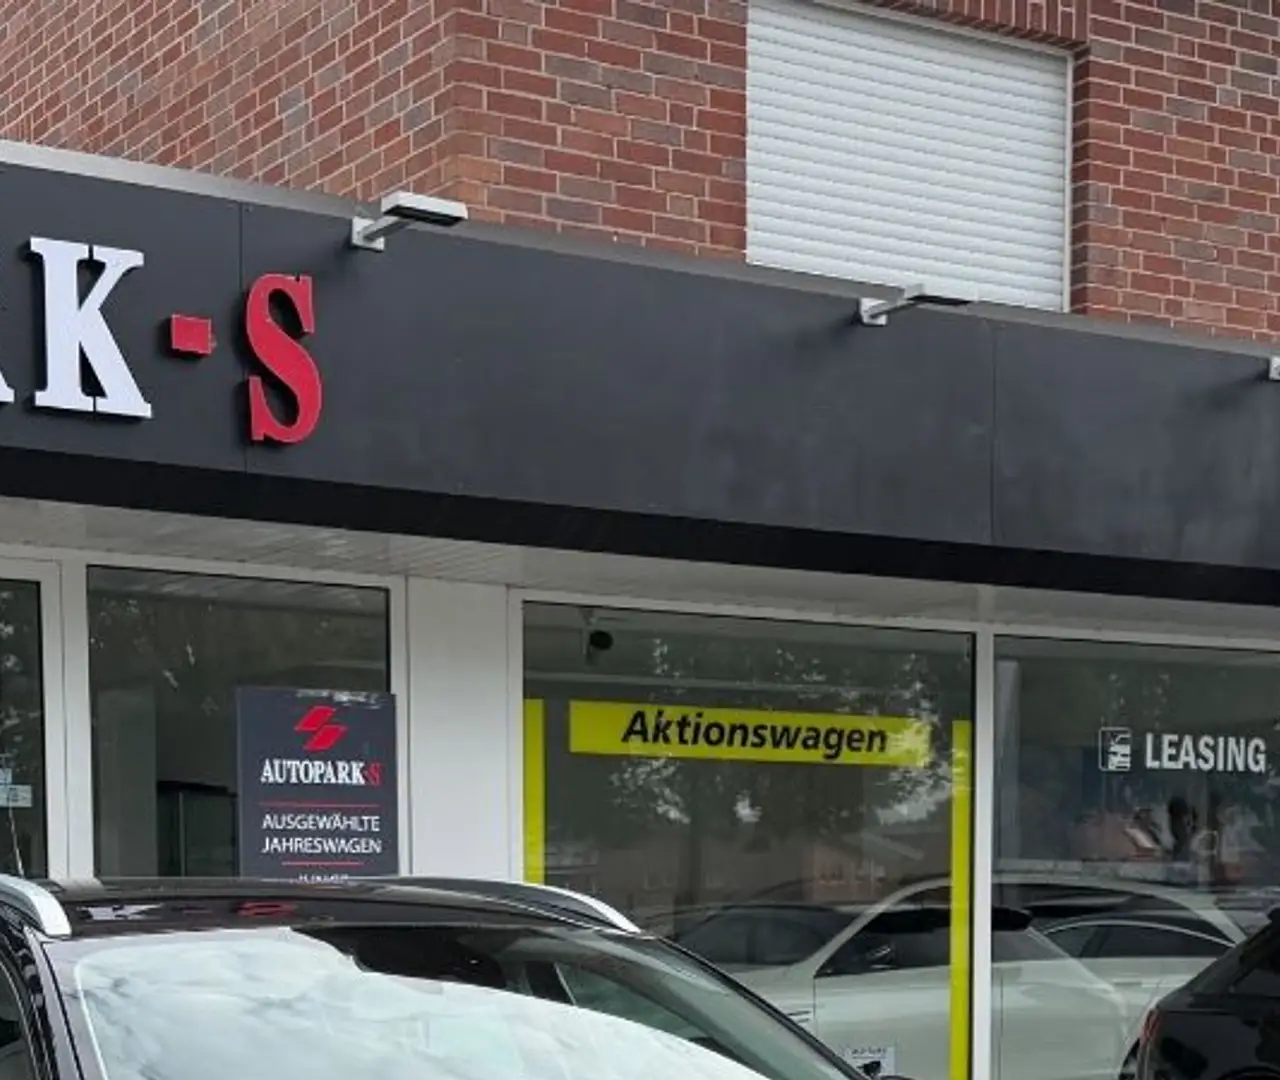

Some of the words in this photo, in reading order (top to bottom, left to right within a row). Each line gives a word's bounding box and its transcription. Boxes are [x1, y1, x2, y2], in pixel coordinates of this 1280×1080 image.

[621, 709, 887, 760] Aktionswagen
[1145, 732, 1266, 772] LEASING
[262, 813, 381, 832] AUSGEWÄHLTE
[261, 837, 382, 854] JAHRESWAGEN
